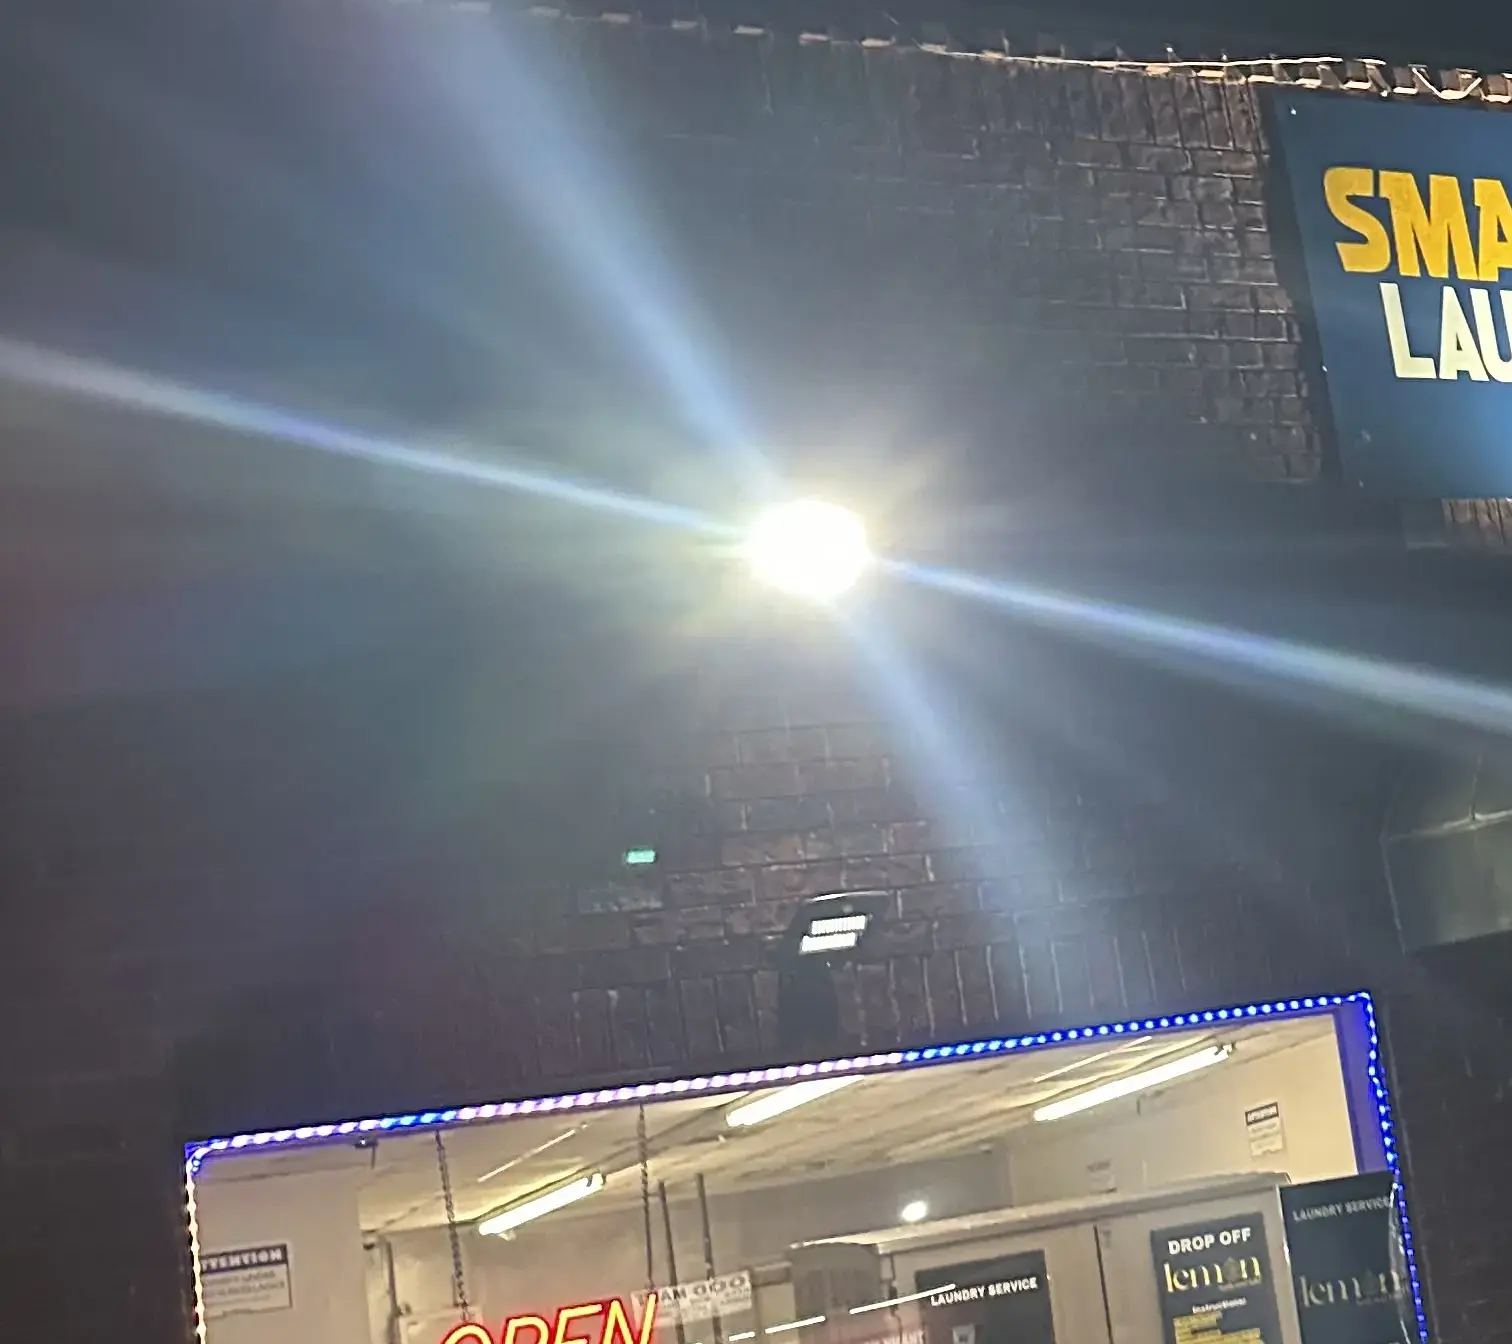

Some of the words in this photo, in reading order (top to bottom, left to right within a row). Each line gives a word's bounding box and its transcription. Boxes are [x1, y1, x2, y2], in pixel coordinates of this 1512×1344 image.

[1292, 1203, 1342, 1222] LAUNDRY
[1168, 1234, 1215, 1255] DROP
[1219, 1227, 1251, 1245] OFF
[200, 1248, 282, 1271] TTENTION
[931, 1285, 986, 1307] LAUNDRY
[988, 1277, 1038, 1297] SERVICE
